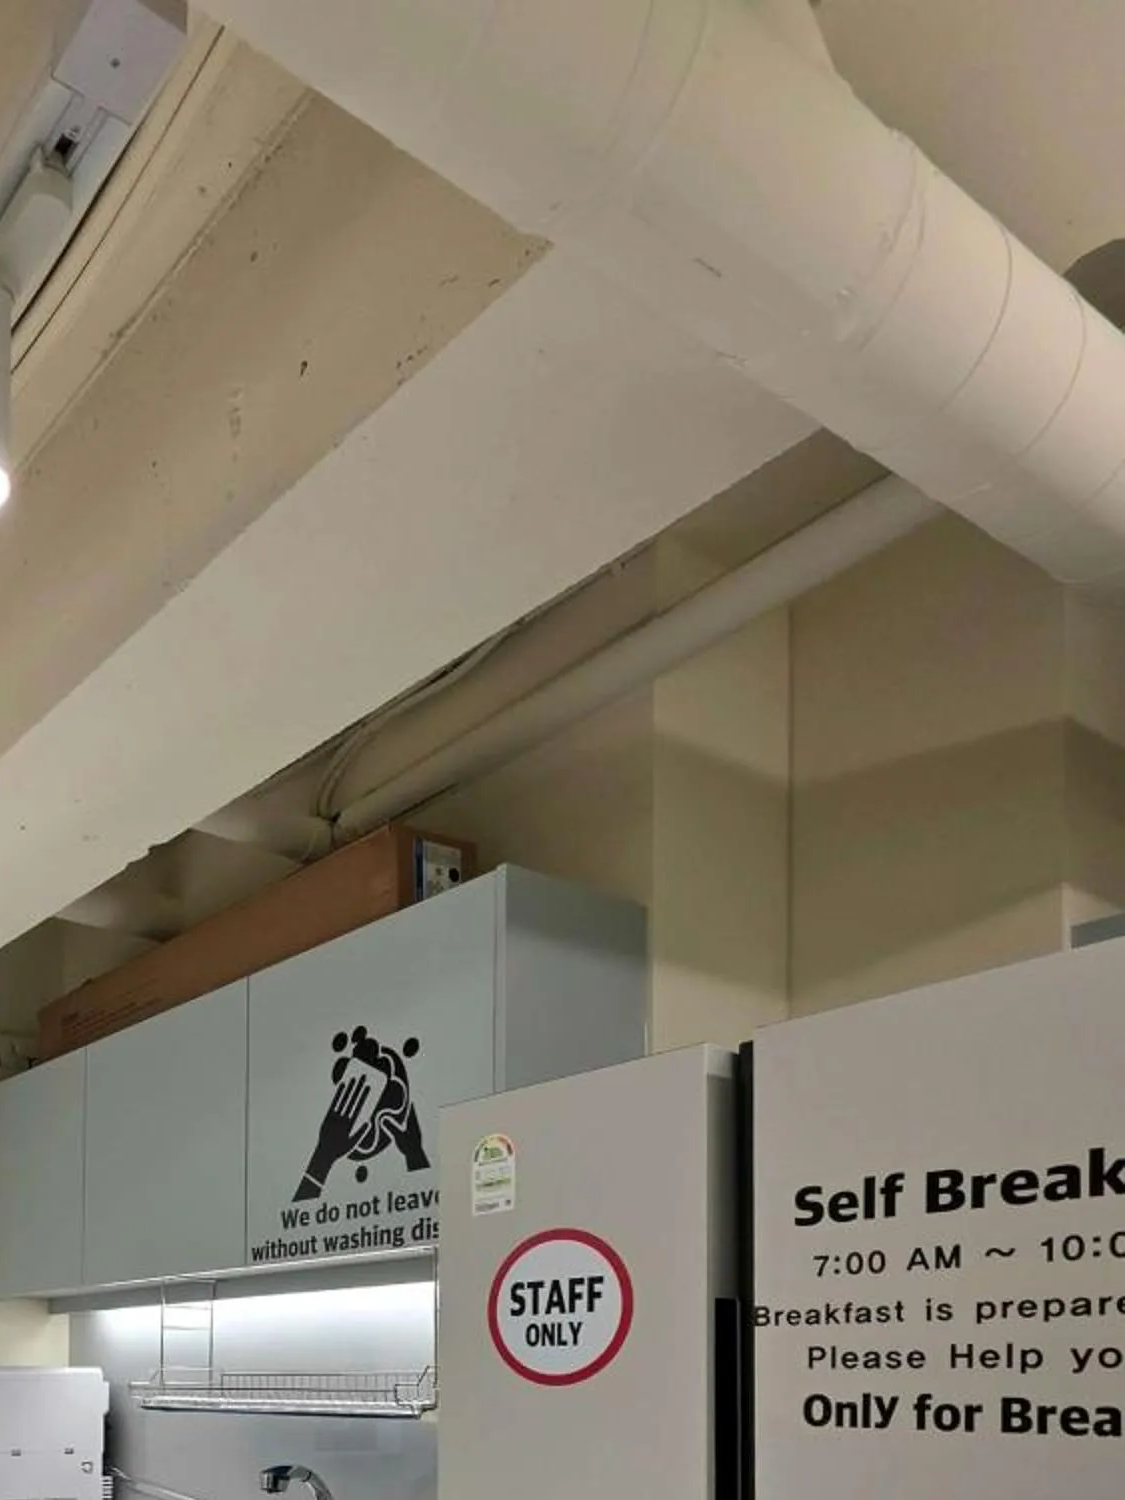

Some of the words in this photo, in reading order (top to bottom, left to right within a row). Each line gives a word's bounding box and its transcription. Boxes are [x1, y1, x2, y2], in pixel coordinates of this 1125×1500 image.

[794, 1173, 905, 1227] Self
[926, 1148, 1125, 1214] Break
[281, 1209, 310, 1230] We
[316, 1203, 340, 1224] do
[346, 1196, 380, 1219] not
[388, 1190, 440, 1213] leav
[251, 1235, 317, 1262] without
[324, 1225, 404, 1252] washing
[813, 1250, 886, 1277] 7:00
[907, 1244, 961, 1271] AM
[510, 1276, 604, 1317] STAFF
[752, 1301, 905, 1326] Breakfast
[925, 1299, 953, 1321] is
[526, 1321, 584, 1347] ONLY
[808, 1346, 926, 1370] Please
[950, 1343, 1043, 1374] Help
[1070, 1347, 1123, 1374] yo
[803, 1393, 899, 1429] Only
[913, 1393, 983, 1432] for
[1001, 1397, 1123, 1437] Brea
